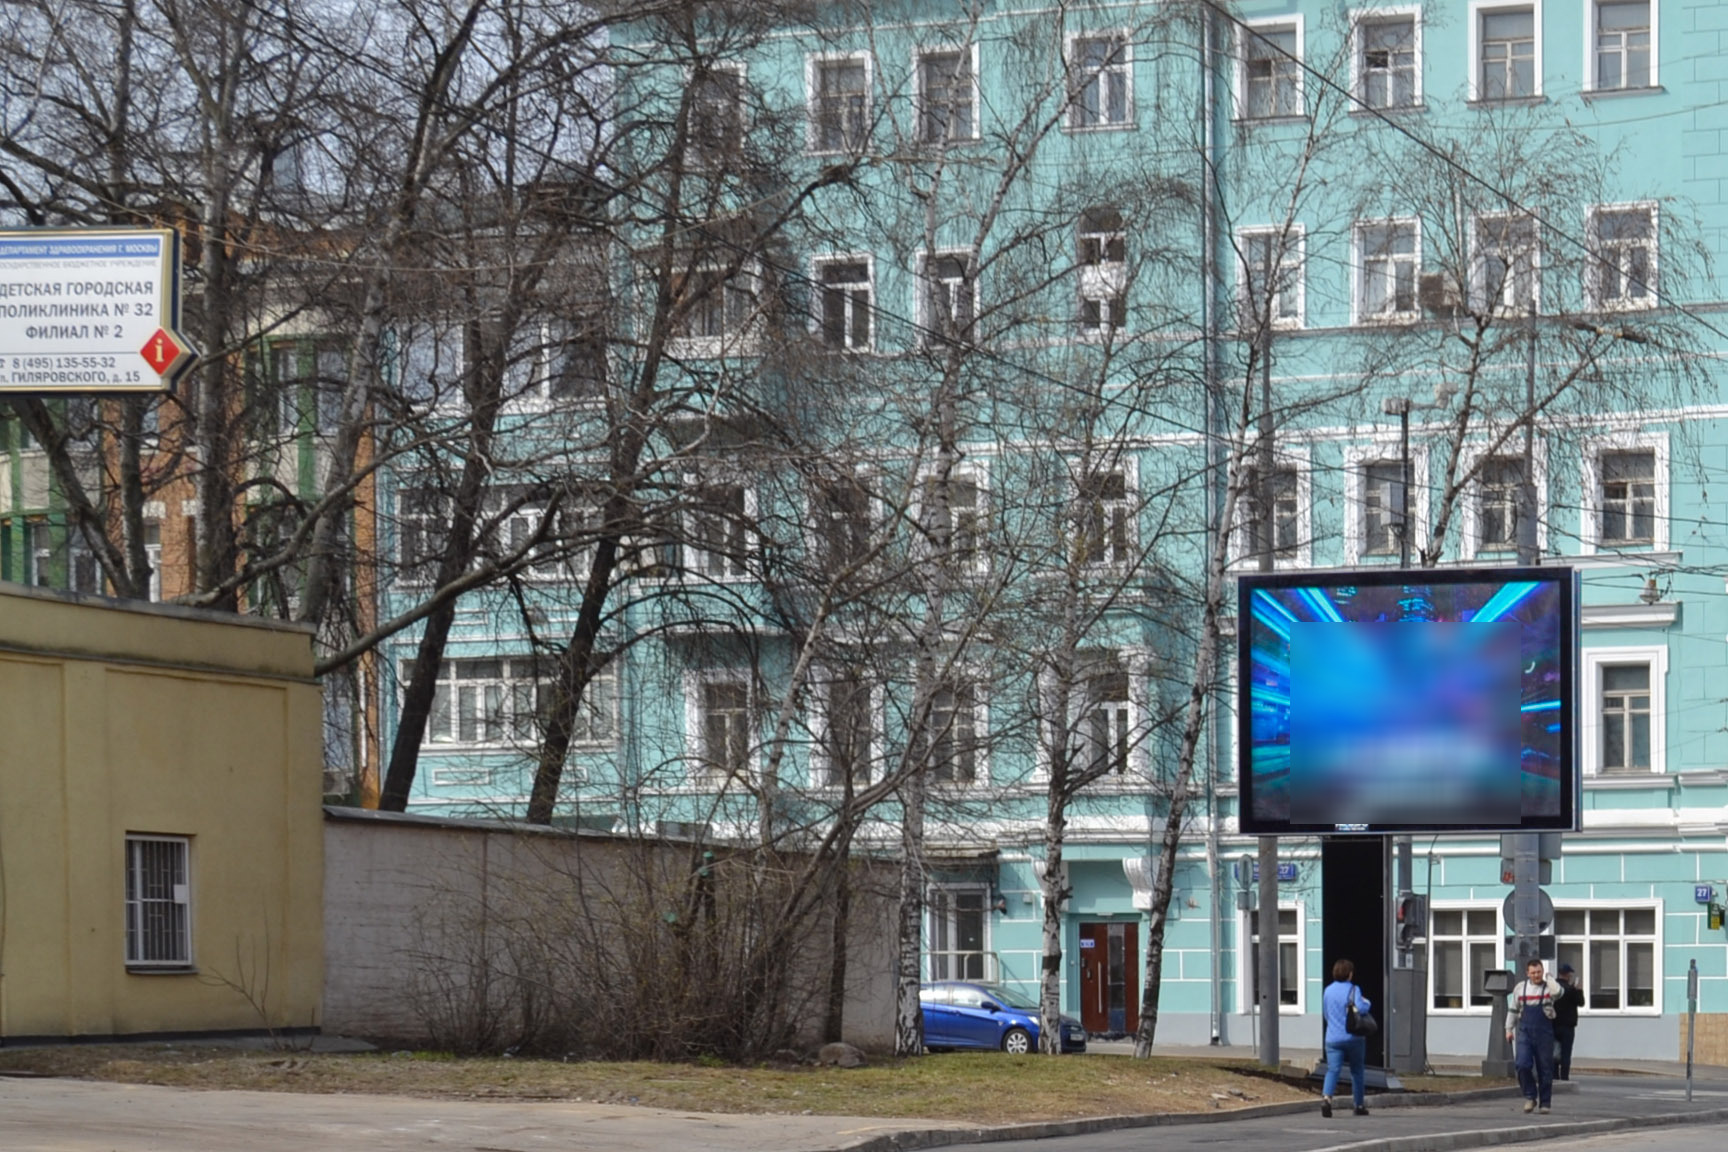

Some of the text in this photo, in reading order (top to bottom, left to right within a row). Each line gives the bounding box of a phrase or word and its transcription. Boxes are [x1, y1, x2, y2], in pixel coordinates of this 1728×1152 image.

[0, 281, 153, 299] ДЕТСКАЯ ГОРОДСКАЯ
[0, 302, 153, 318] ПОЛИКЛИНИКА № 32
[25, 324, 123, 339] ФИЛИАЛ № 2
[12, 356, 116, 371] 8 (495) 135-55-32
[126, 371, 140, 383] 15
[1696, 887, 1708, 897] 27
